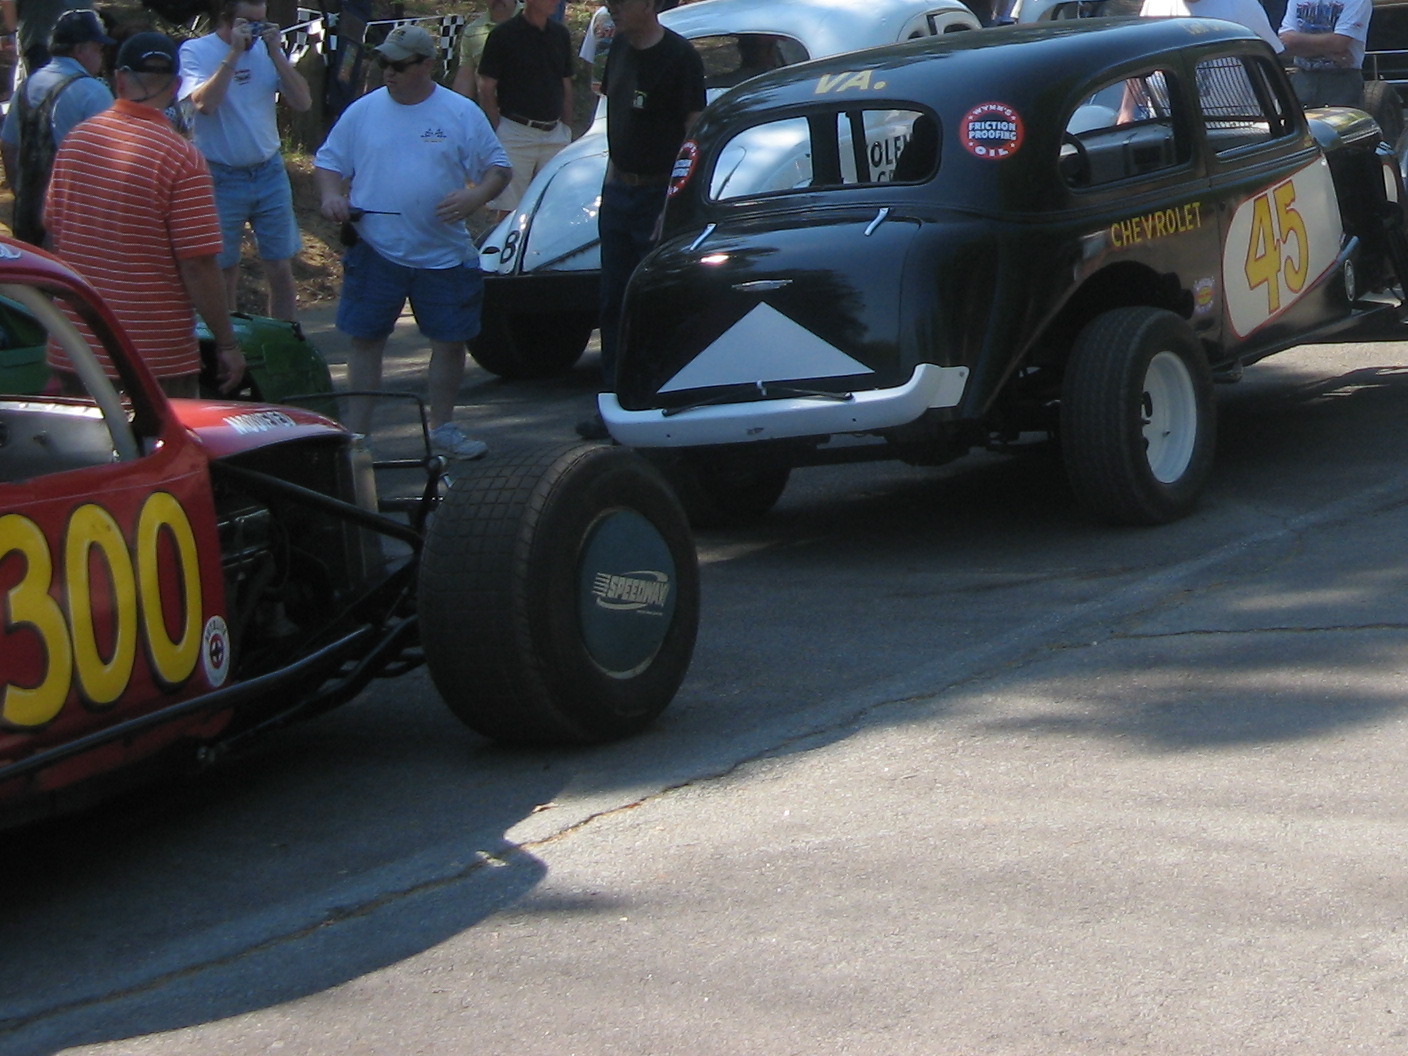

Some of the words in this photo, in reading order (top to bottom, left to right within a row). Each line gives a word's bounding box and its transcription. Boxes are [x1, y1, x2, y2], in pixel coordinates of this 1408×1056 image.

[815, 69, 887, 94] VA.
[968, 121, 1016, 131] FRICTION
[968, 130, 1017, 141] PROOFING
[974, 146, 1009, 157] OIL
[1111, 202, 1200, 248] CHEVROLET
[1244, 179, 1309, 315] 45
[606, 575, 669, 607] SPEEDWAY
[0, 490, 204, 728] 300
